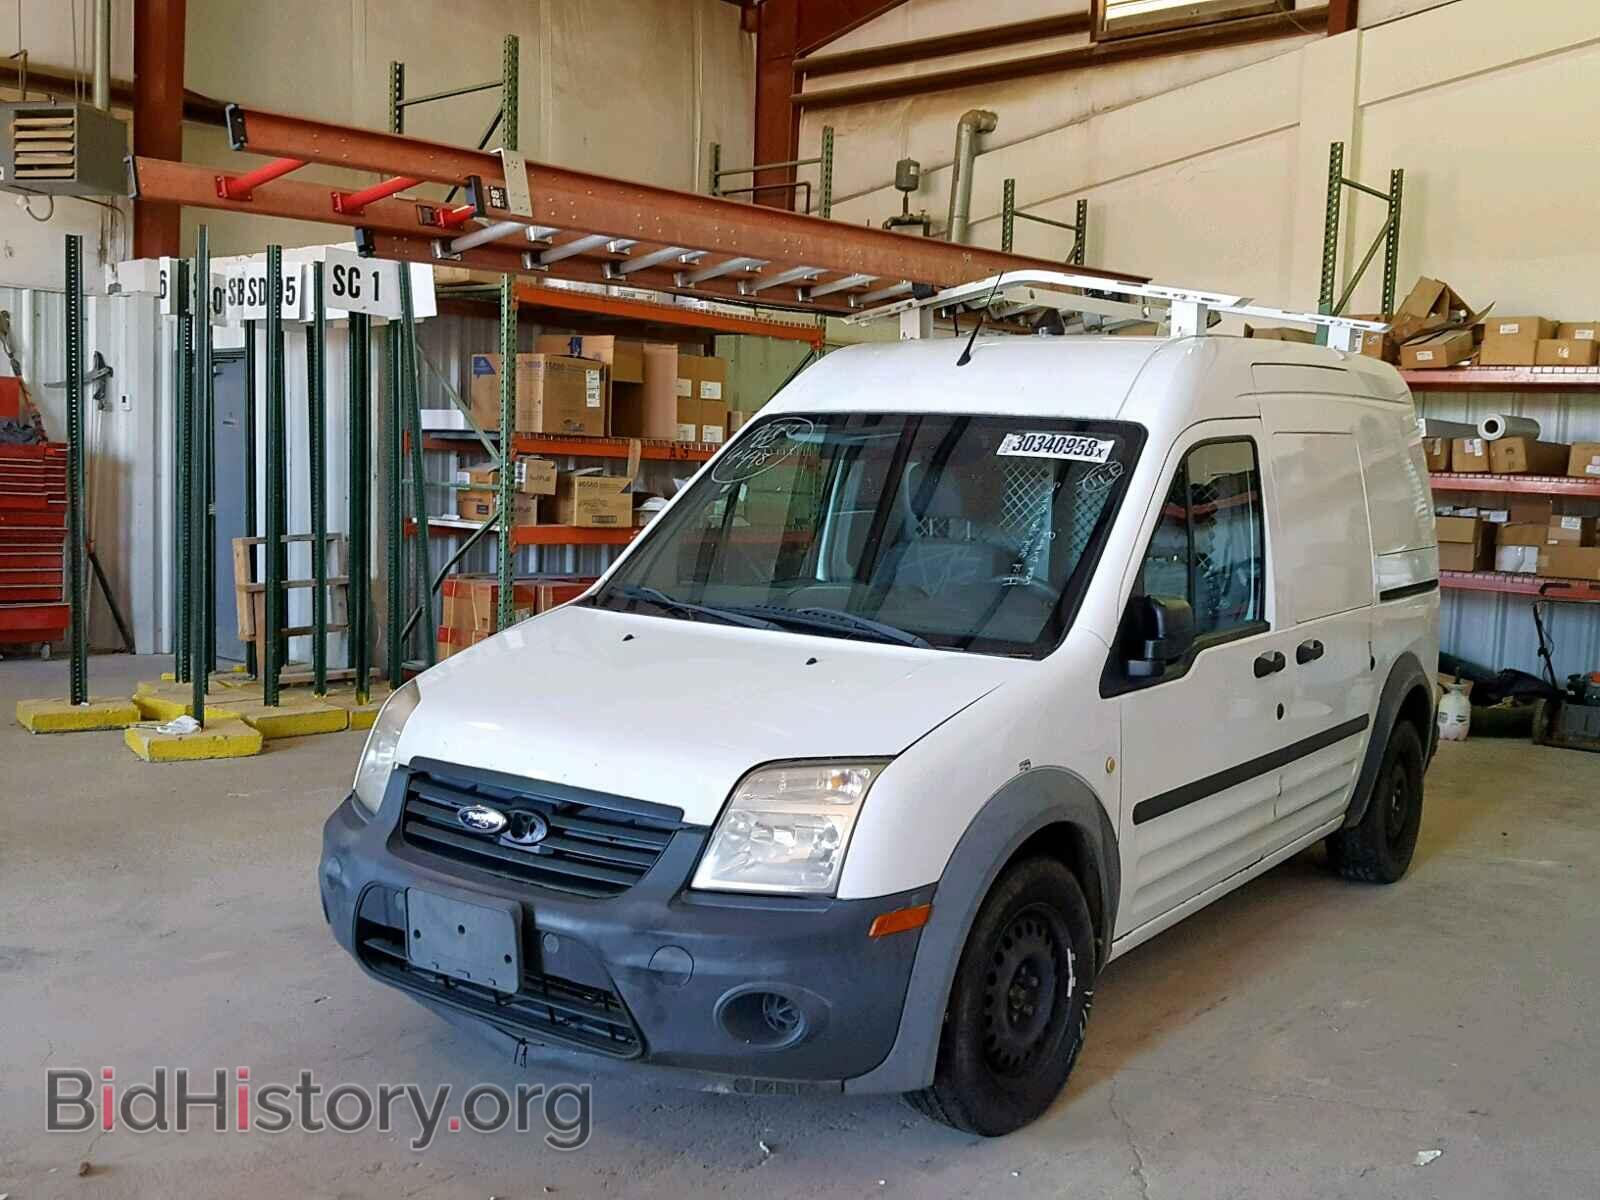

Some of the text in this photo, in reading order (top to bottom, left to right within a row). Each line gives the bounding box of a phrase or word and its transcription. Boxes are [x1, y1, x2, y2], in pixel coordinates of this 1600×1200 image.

[228, 278, 245, 305] SB
[280, 275, 296, 305] 5
[332, 264, 380, 302] SC 1
